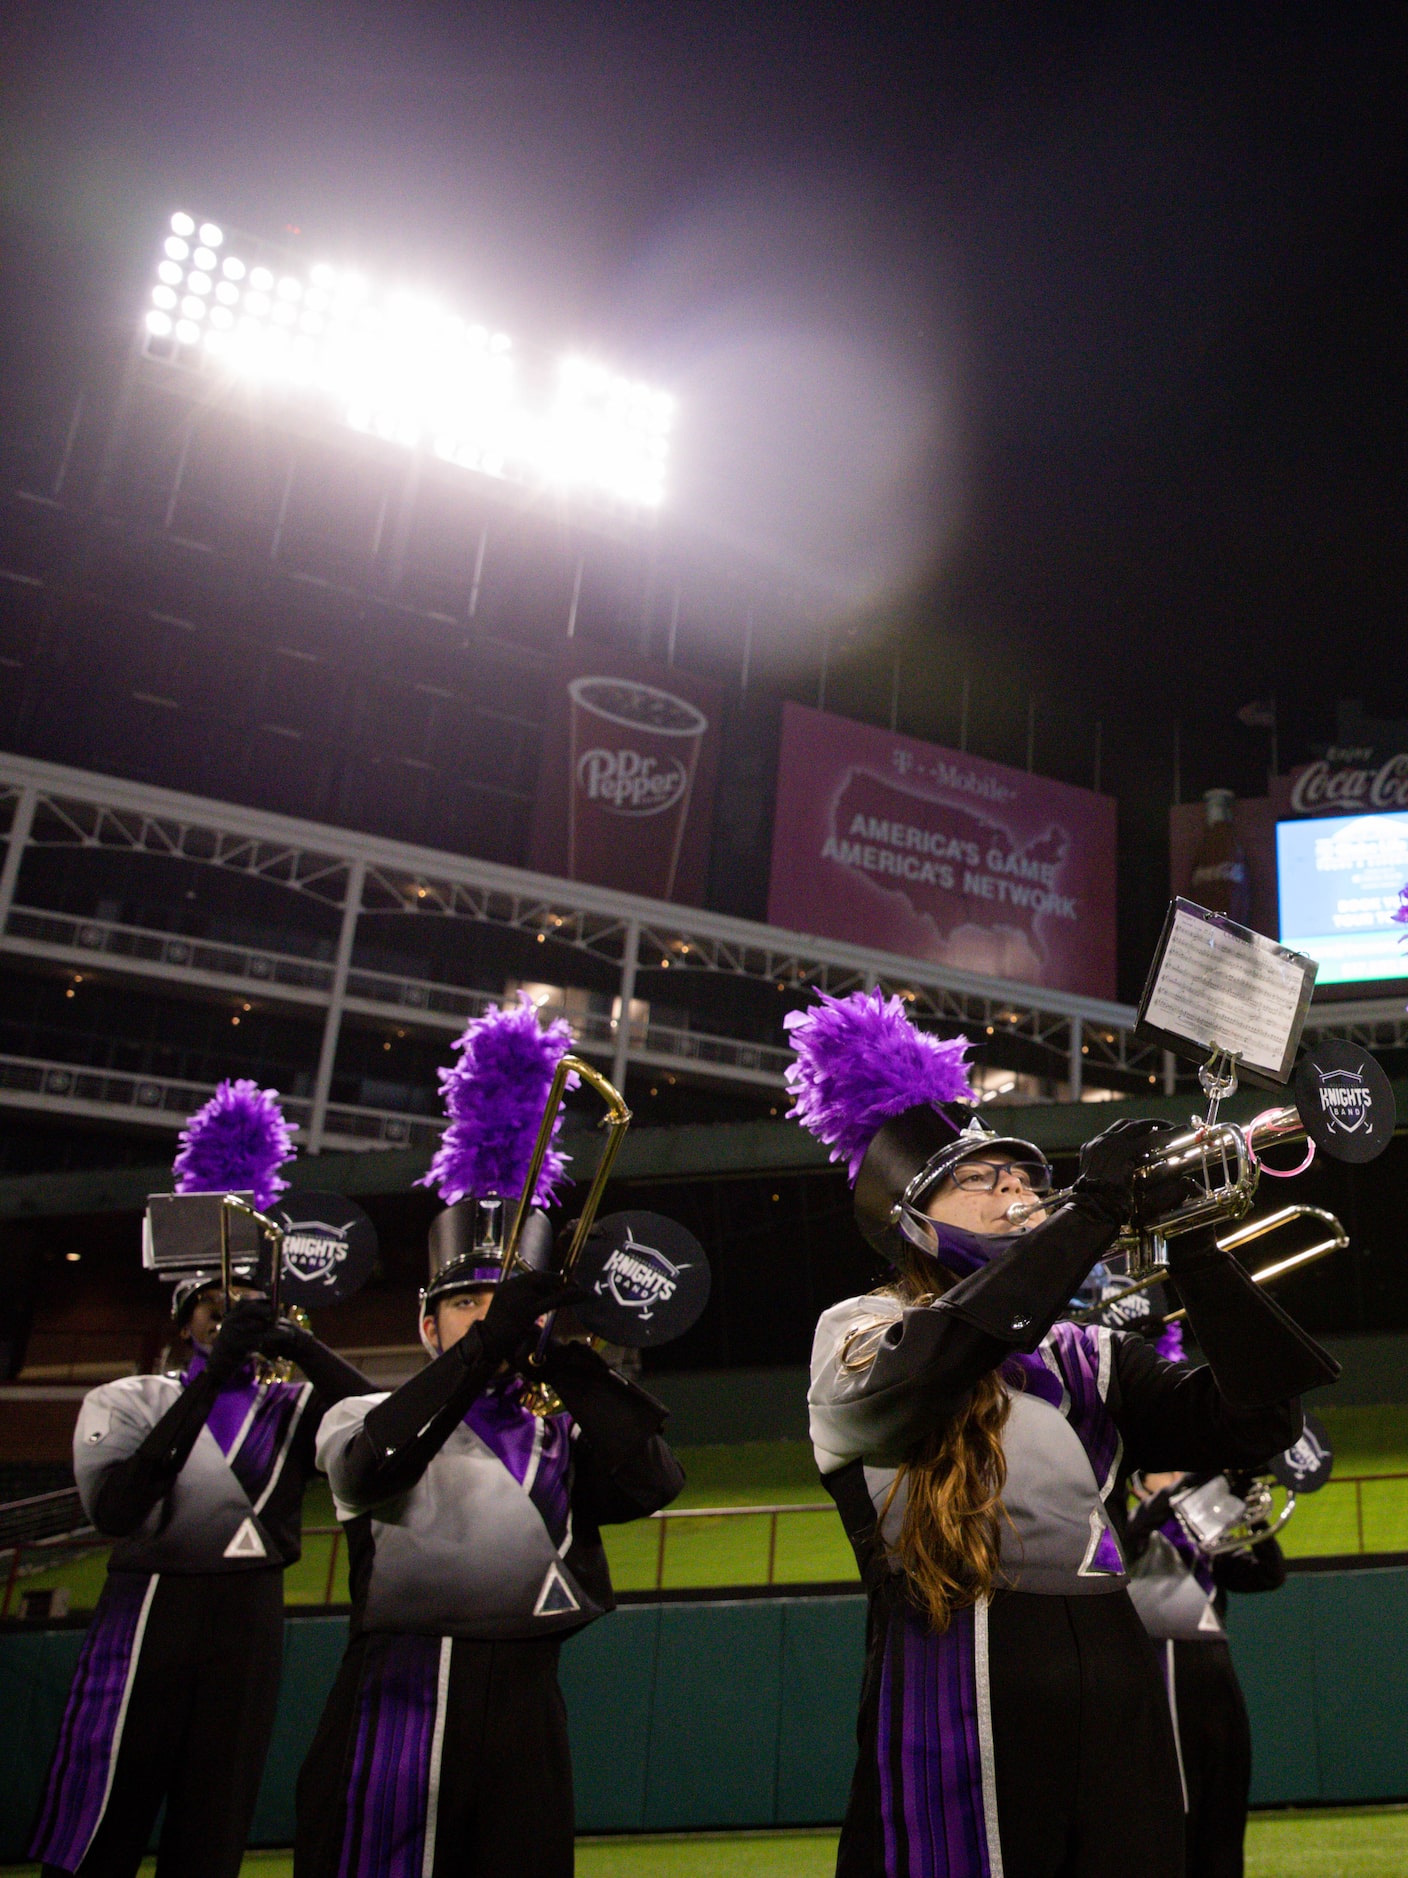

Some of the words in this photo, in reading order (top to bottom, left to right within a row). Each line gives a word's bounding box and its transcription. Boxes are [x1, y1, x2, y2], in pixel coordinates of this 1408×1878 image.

[577, 747, 681, 807] Pepper
[616, 747, 659, 780] Dr
[849, 811, 981, 868] AMERICA'S
[986, 847, 1059, 888] GAME
[820, 836, 956, 891] AMERICA'S
[962, 869, 1079, 922] NETWORK
[1318, 1087, 1373, 1112] KNIGHTS
[1333, 1107, 1361, 1117] BAND
[601, 1248, 678, 1302] KNIGHTS
[614, 1273, 650, 1300] BAND
